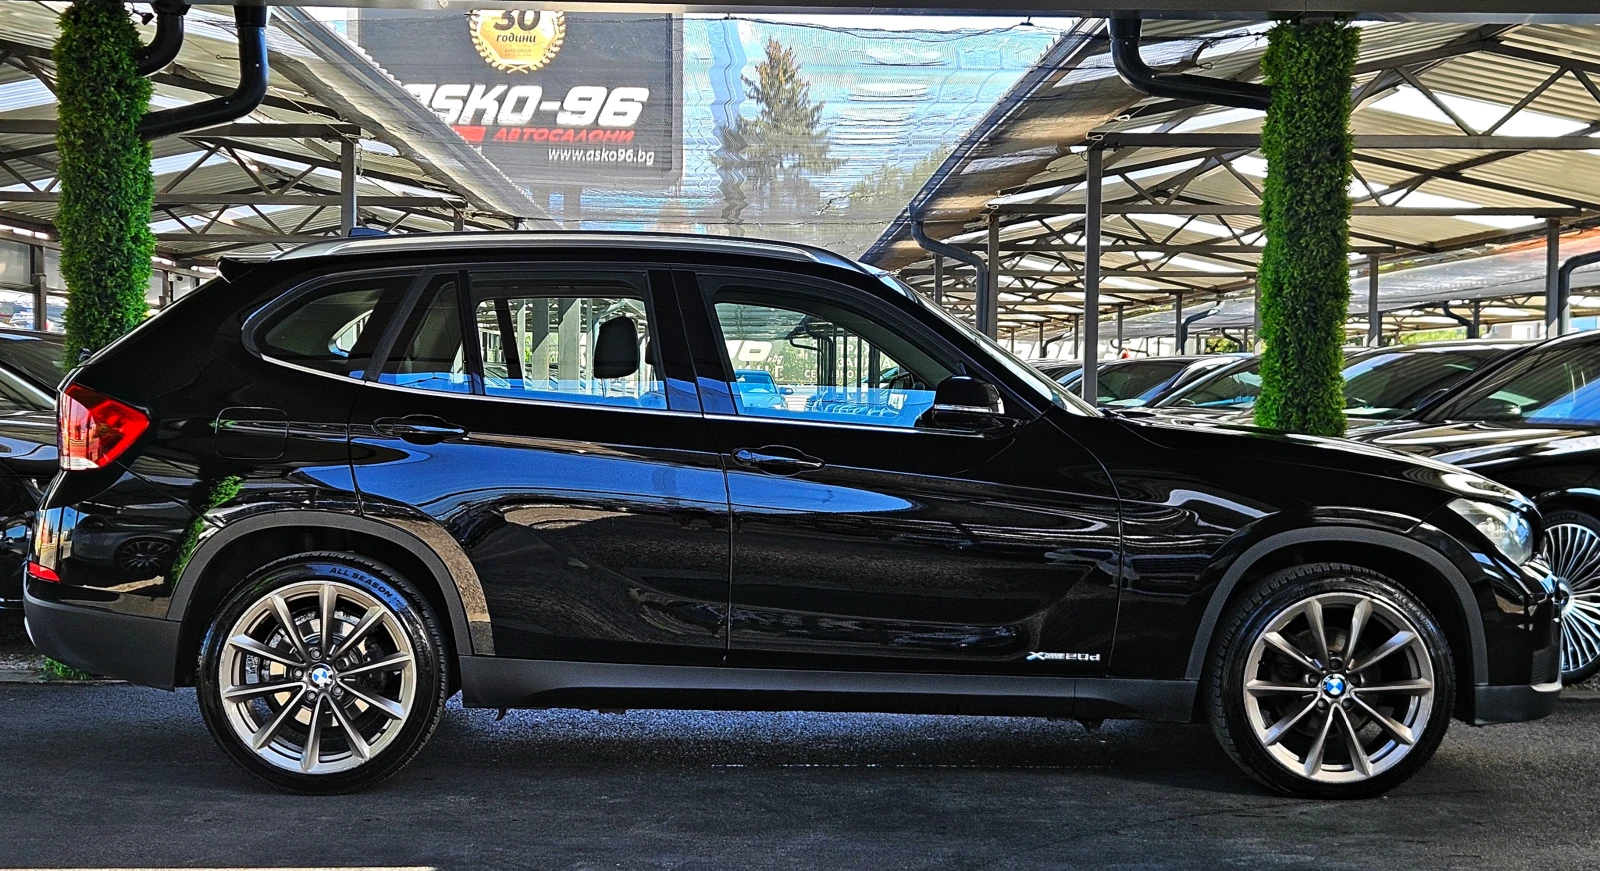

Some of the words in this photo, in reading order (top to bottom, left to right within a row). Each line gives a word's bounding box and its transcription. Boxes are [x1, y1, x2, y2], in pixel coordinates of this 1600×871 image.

[493, 10, 541, 31] 30
[496, 33, 537, 44] години
[493, 127, 635, 143] АВТОСАЛОНИ
[548, 147, 655, 166] www.asko96.bg
[330, 567, 349, 577] ALL
[351, 572, 394, 598] SEASON
